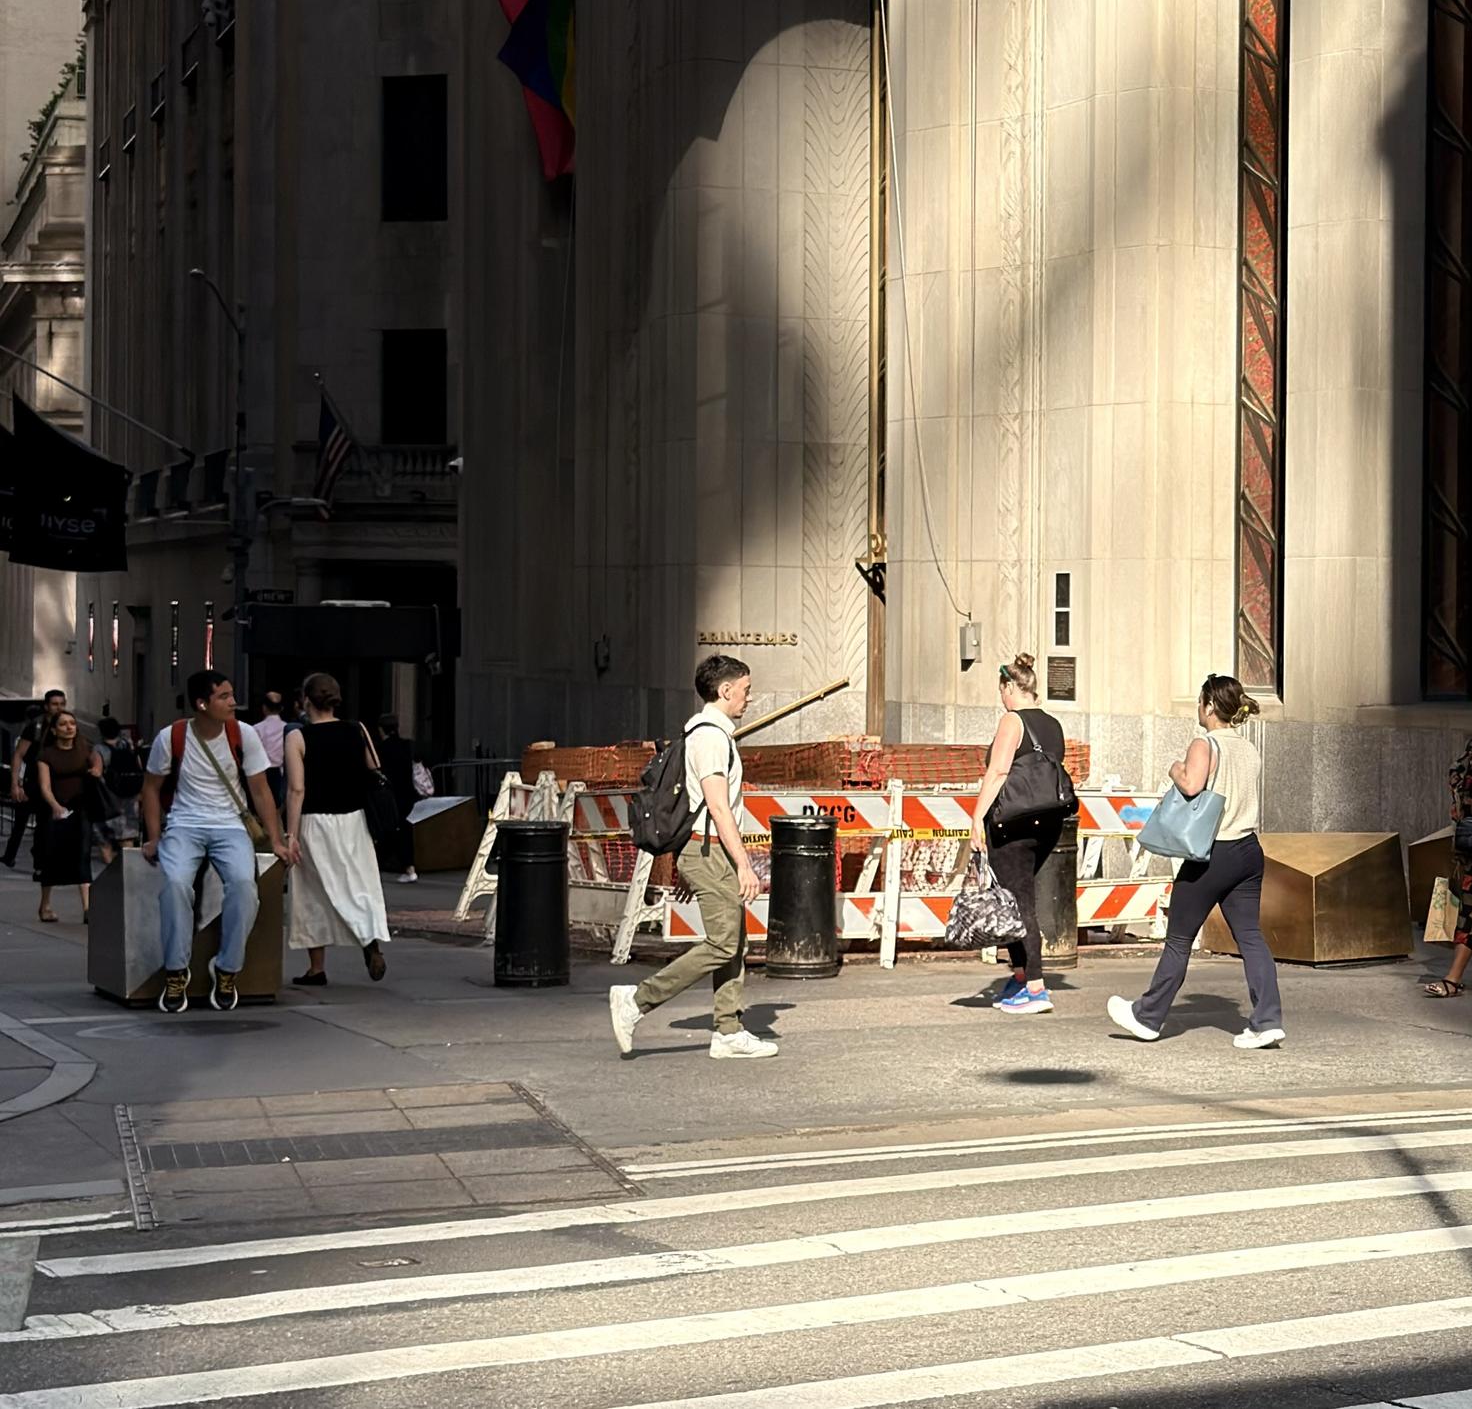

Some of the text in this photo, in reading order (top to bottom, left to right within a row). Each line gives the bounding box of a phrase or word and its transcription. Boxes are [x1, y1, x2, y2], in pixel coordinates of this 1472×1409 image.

[698, 632, 797, 645] PRINTEMPS
[932, 829, 970, 838] CAUTION
[742, 835, 770, 845] AUTIO
